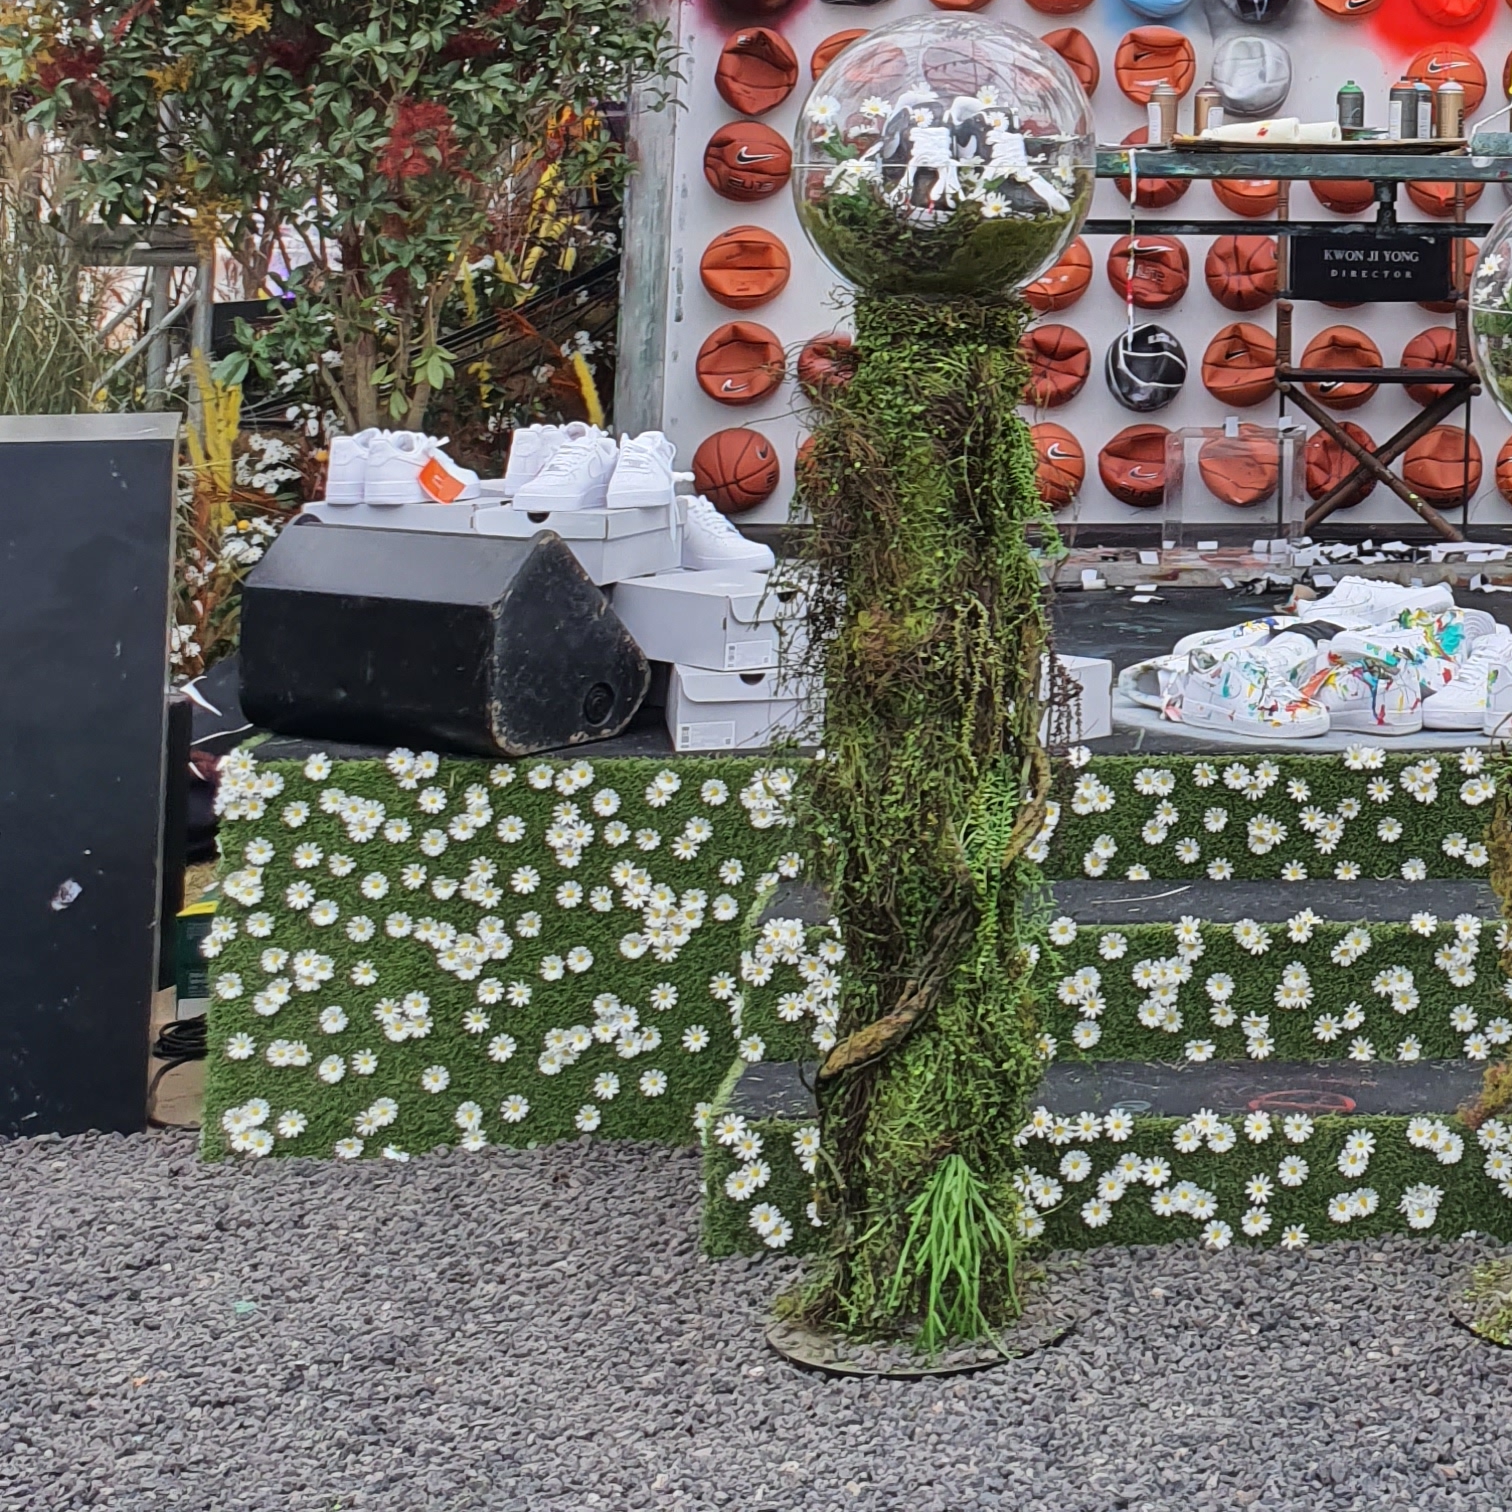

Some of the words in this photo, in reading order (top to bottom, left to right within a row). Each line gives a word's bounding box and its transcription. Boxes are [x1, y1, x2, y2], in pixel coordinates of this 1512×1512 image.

[1323, 249, 1365, 262] KWON
[1366, 250, 1380, 263] JI
[1382, 250, 1420, 263] YONG
[1330, 269, 1413, 279] DIRECTOR
